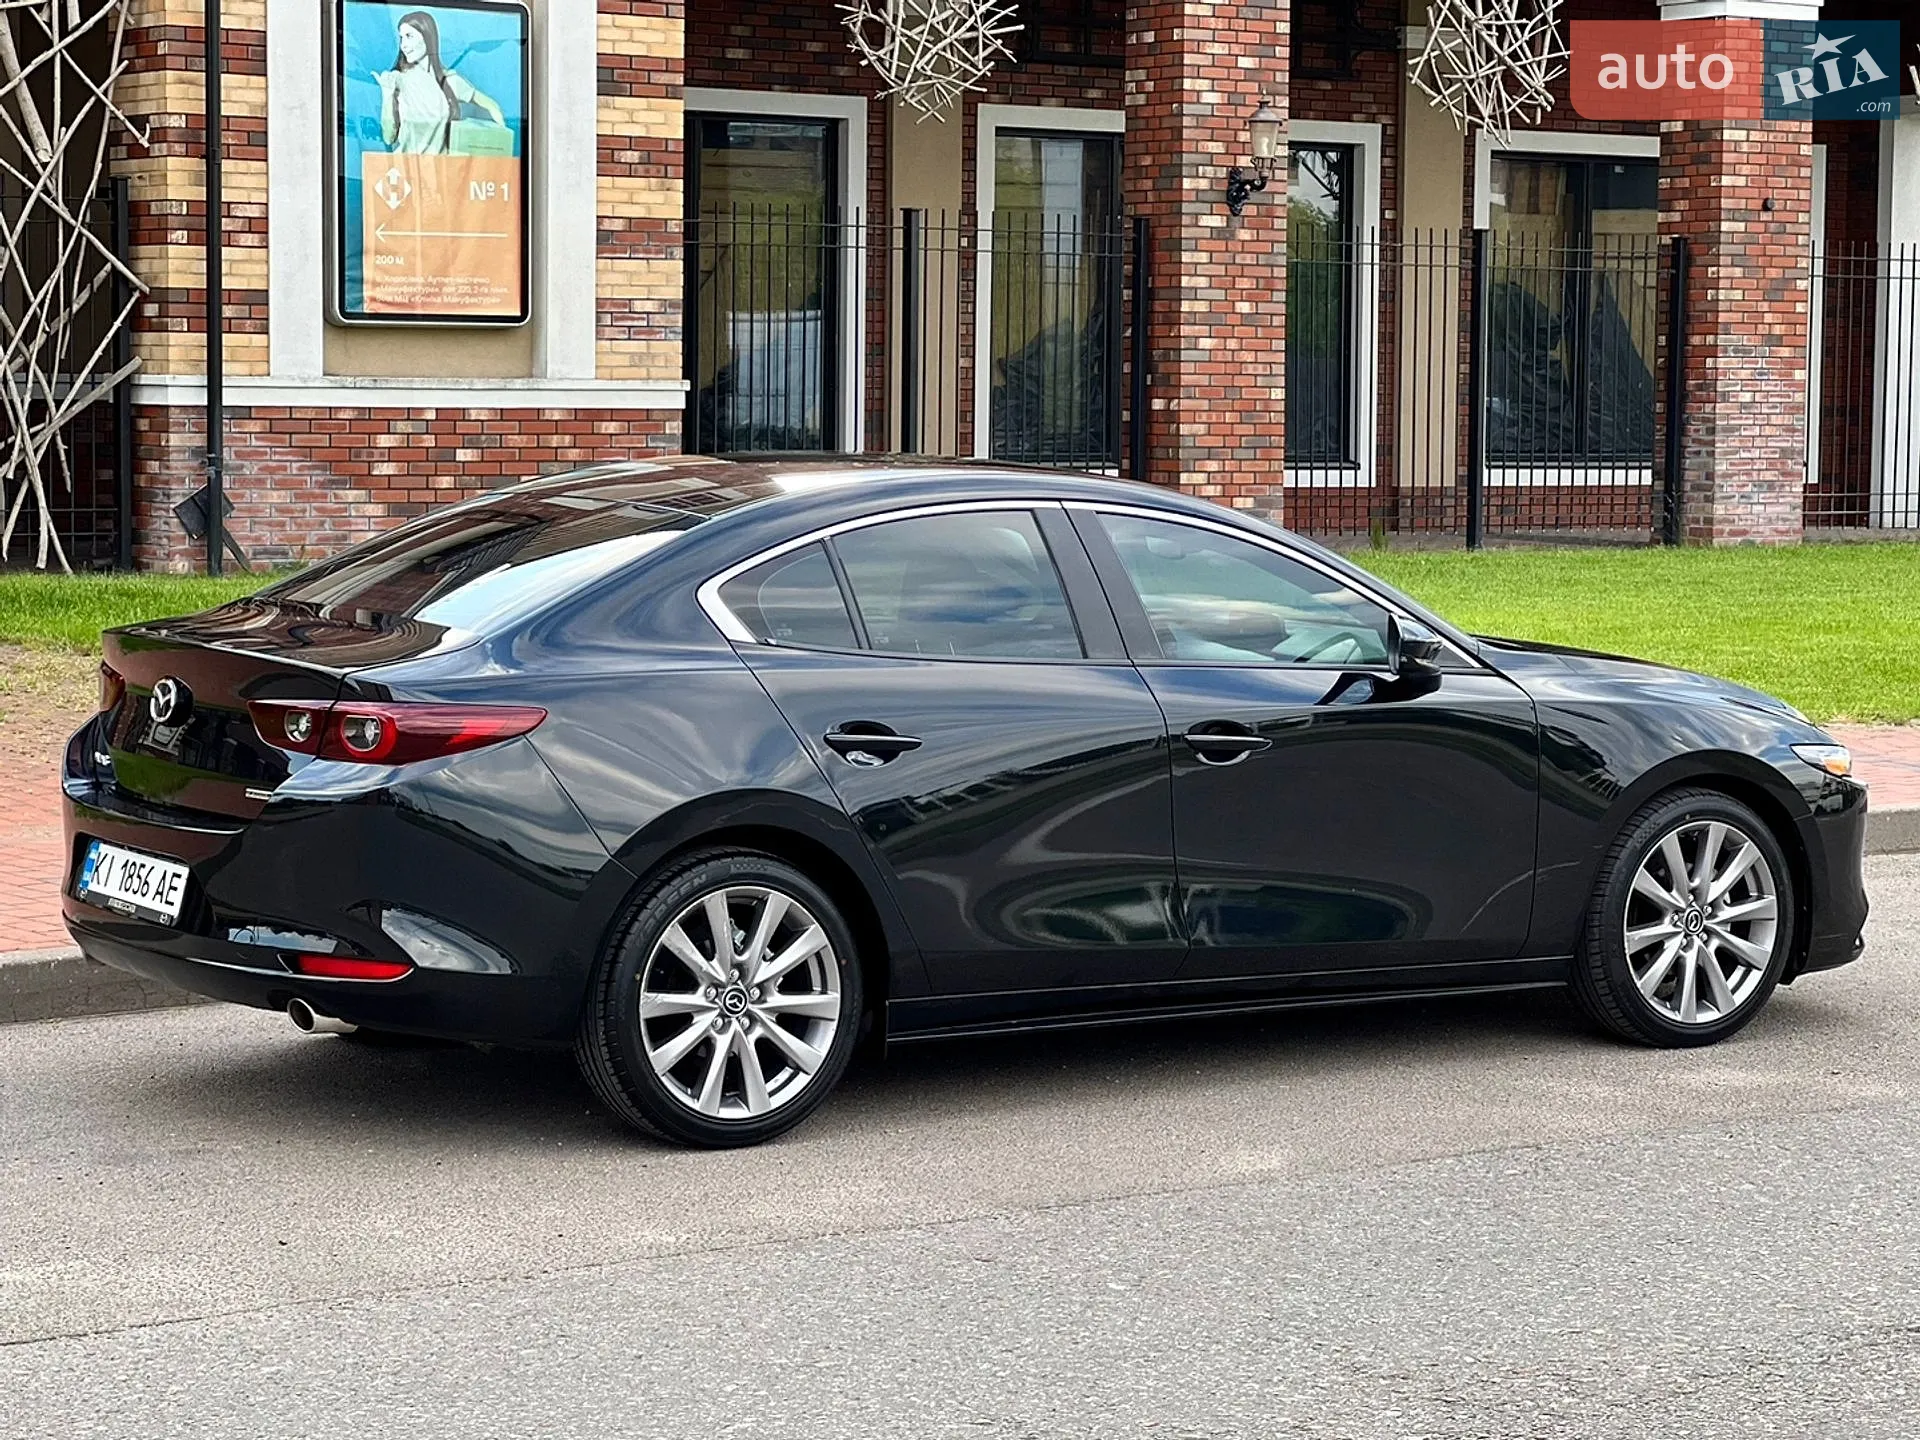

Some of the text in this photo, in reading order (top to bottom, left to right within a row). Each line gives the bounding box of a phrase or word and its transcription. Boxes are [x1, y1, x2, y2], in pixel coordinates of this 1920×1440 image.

[500, 182, 509, 202] 1
[375, 255, 394, 265] 200
[91, 852, 115, 887] KI
[118, 859, 155, 898] 1856
[152, 869, 182, 907] AE
